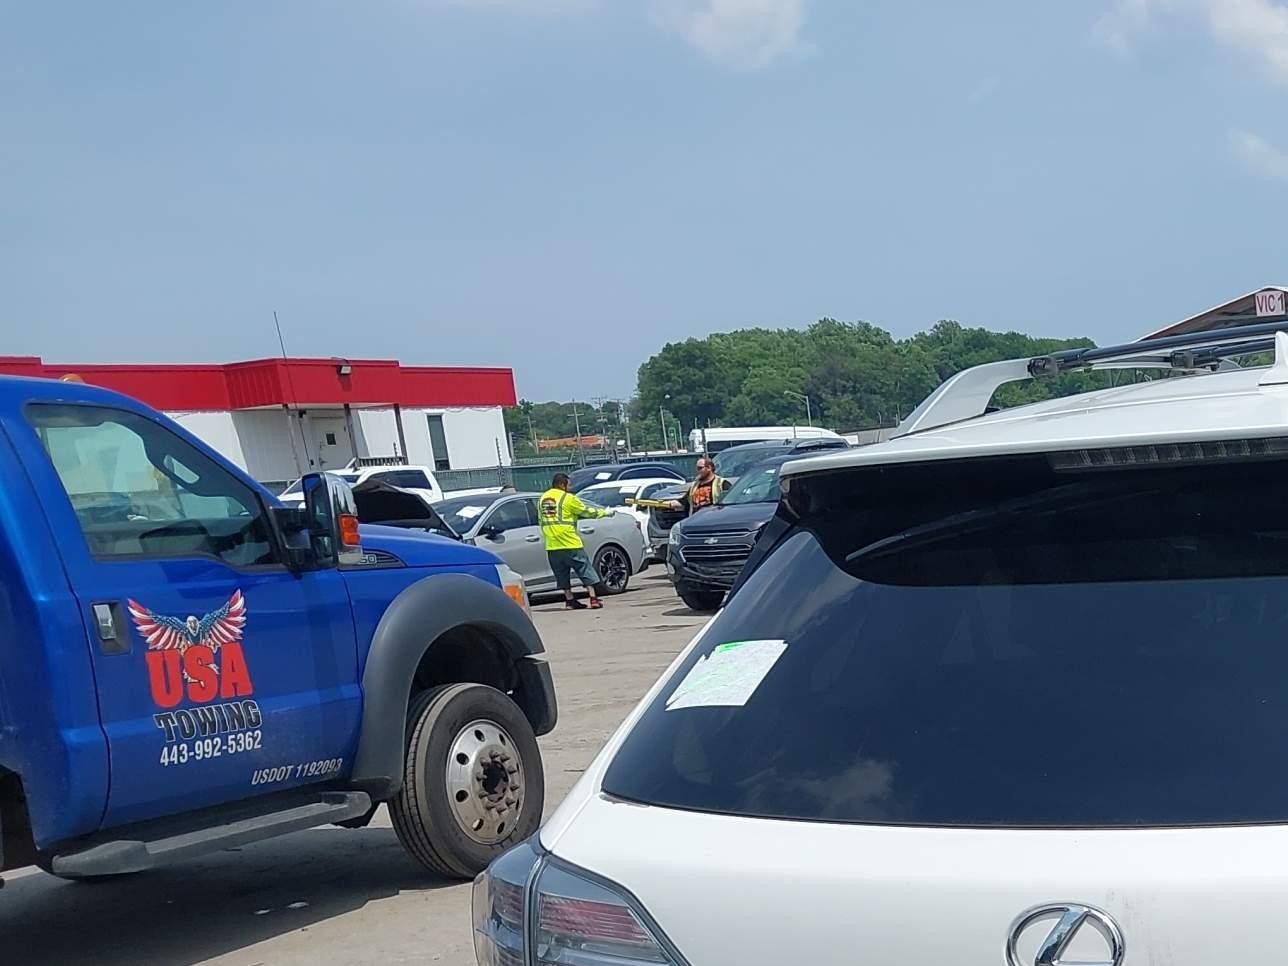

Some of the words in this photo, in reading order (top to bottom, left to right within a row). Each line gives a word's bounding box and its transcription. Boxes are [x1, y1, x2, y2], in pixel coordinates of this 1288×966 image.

[1256, 294, 1276, 313] VIC
[1277, 294, 1284, 312] 1
[145, 642, 253, 708] USA
[154, 700, 262, 742] TOWING
[160, 730, 262, 766] 443-992-5362
[251, 765, 293, 785] USDOT
[295, 758, 343, 778] 1192093
